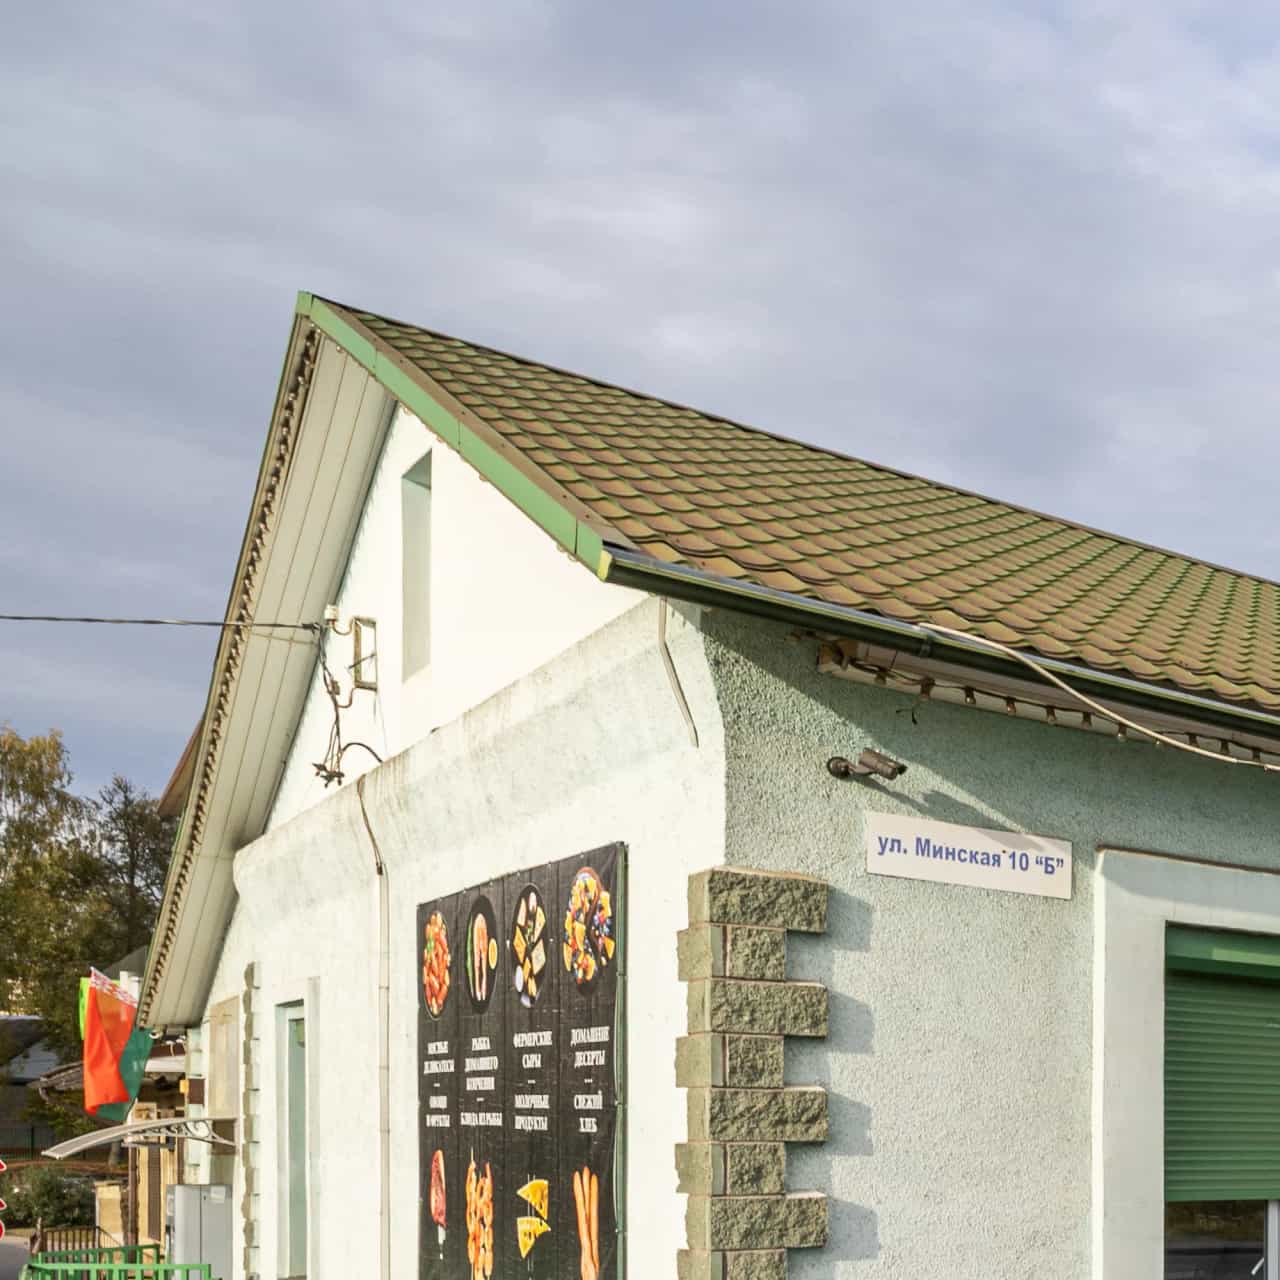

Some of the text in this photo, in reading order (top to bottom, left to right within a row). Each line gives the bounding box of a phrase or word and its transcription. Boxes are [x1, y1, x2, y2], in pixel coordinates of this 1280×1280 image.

[878, 836, 908, 856] ул.
[915, 836, 1001, 868] Минская
[1008, 851, 1029, 872] 10
